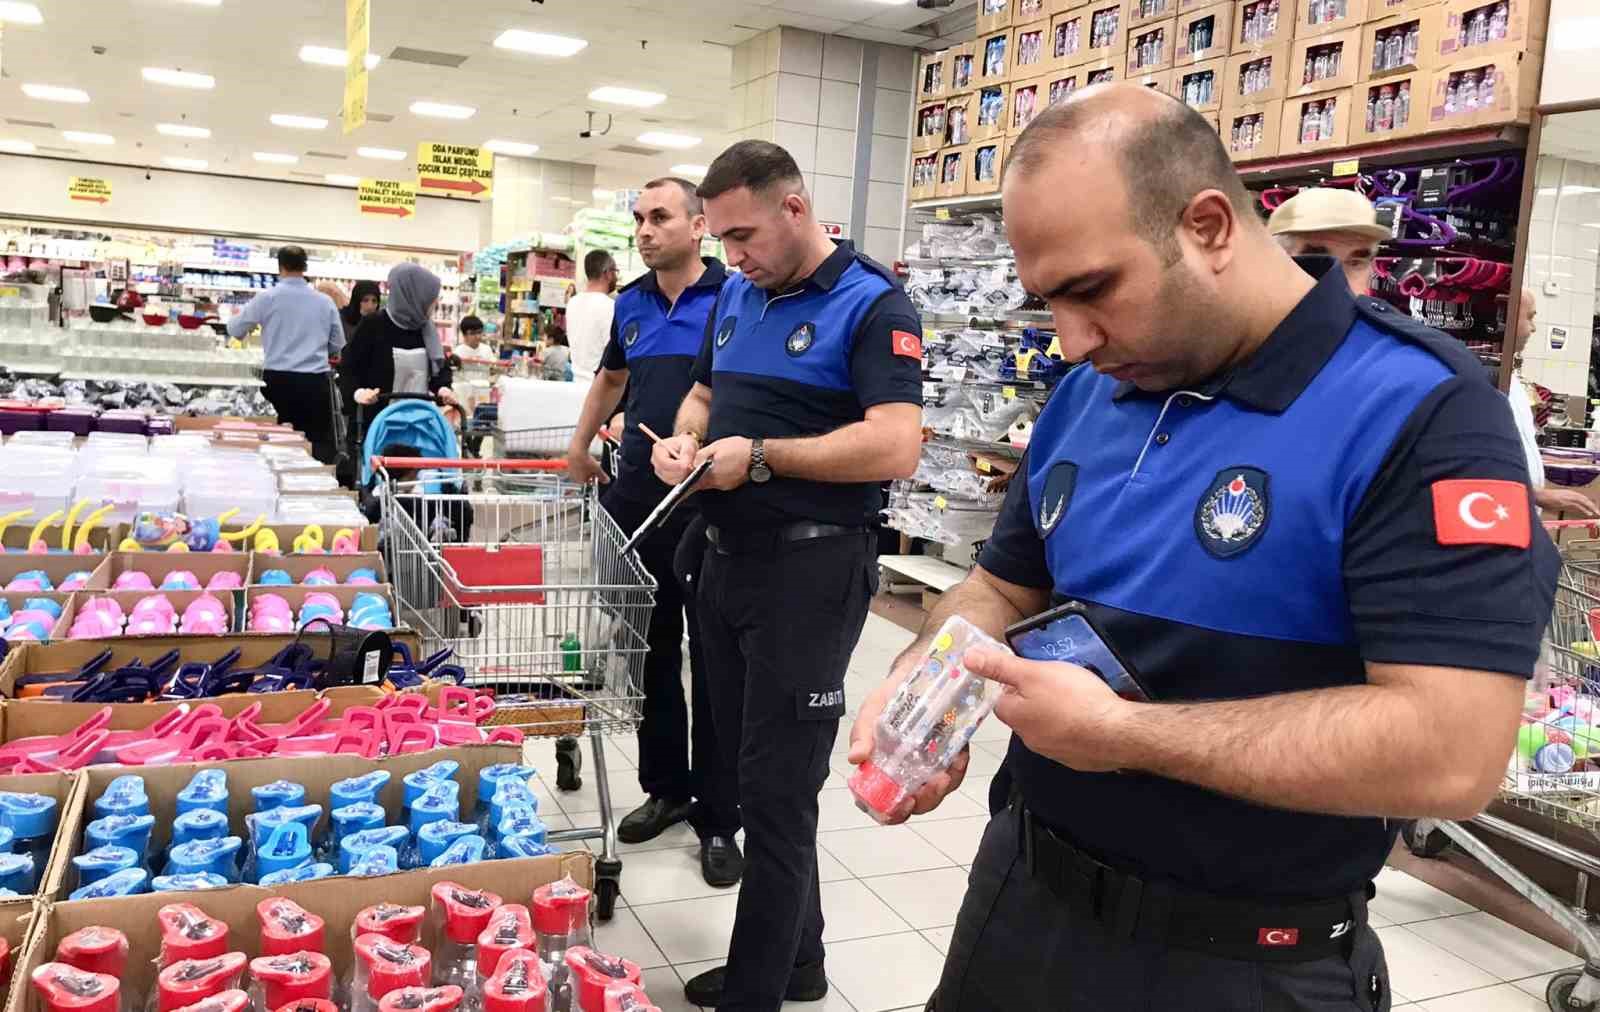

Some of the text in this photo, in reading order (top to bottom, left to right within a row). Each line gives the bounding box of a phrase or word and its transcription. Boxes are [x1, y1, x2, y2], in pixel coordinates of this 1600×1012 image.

[432, 144, 446, 153] ODA
[417, 163, 441, 174] ÇOCUK
[1041, 636, 1078, 657] 12:52
